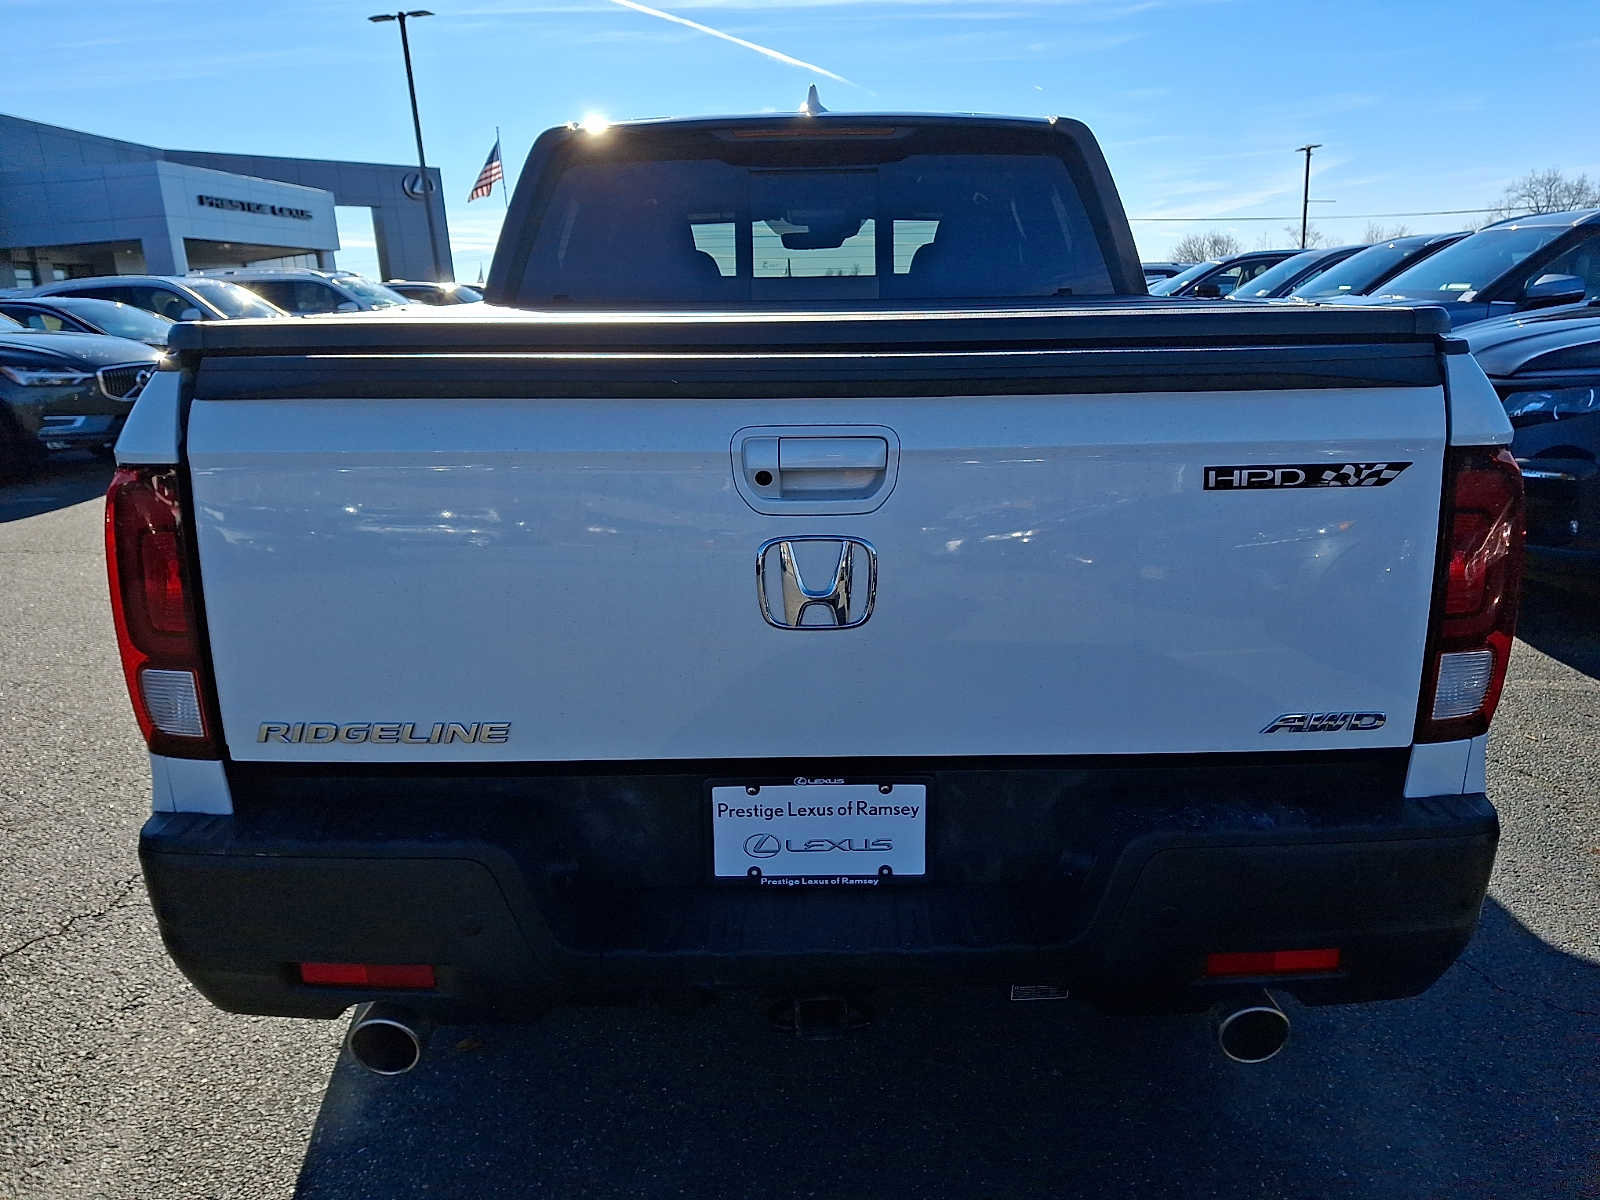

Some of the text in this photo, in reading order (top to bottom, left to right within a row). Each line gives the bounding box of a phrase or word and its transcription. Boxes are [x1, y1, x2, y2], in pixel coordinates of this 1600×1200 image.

[1208, 468, 1306, 487] HPD
[1260, 711, 1387, 734] AWD
[256, 722, 512, 744] RIDGELINE
[717, 800, 919, 820] Prestige Lexus of Ramsey
[785, 839, 893, 852] LEXUS
[761, 877, 879, 886] Prestige Lexus of Ramsey
